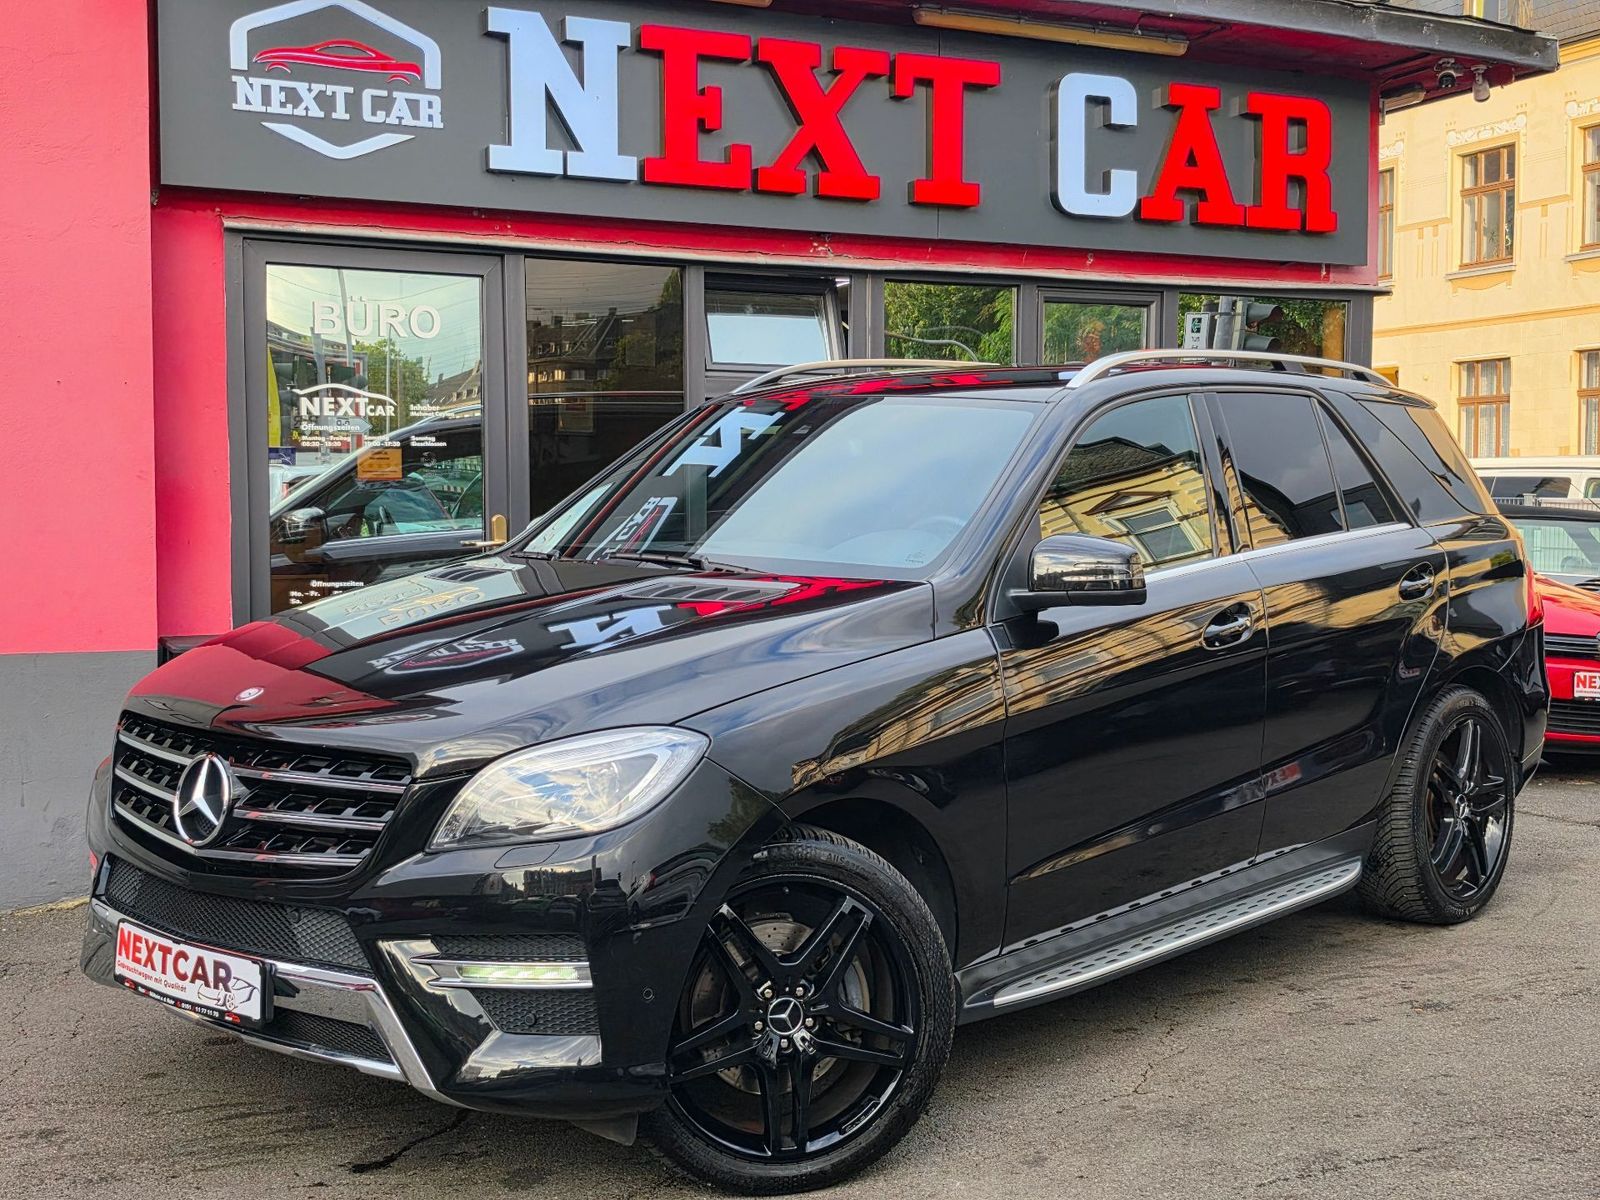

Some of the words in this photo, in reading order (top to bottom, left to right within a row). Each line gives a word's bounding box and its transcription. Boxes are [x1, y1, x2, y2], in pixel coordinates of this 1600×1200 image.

[231, 76, 354, 120] NEXT
[362, 88, 444, 129] CAR
[485, 6, 1000, 207] NEXT
[1050, 71, 1338, 233] CAR
[312, 296, 441, 339] BÜRO
[301, 421, 360, 432] Öffnungszeiten
[310, 580, 364, 588] Öffnungszeiten
[1576, 674, 1600, 689] NE
[118, 927, 233, 993] NEXTCAR
